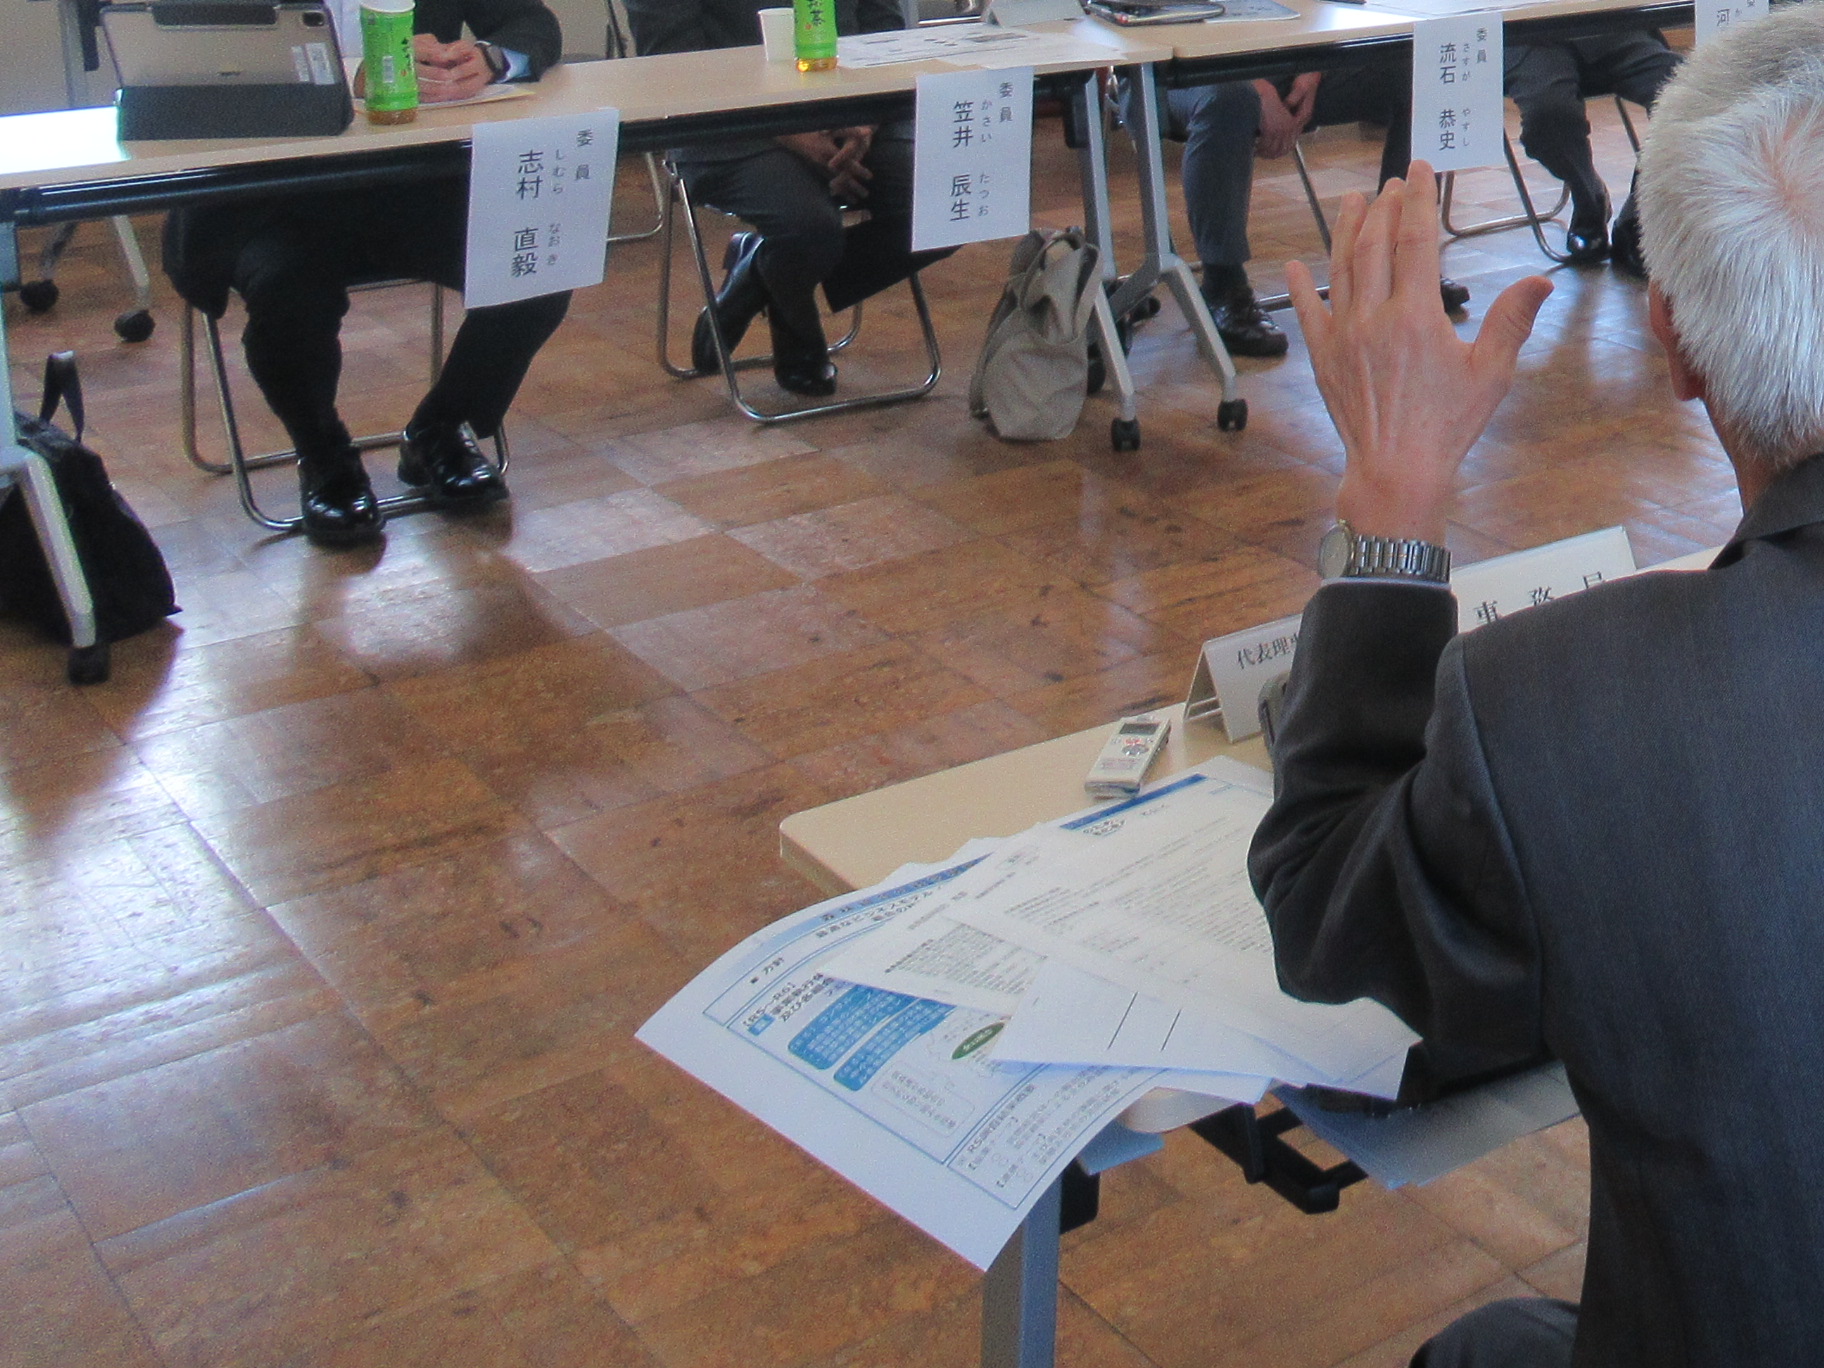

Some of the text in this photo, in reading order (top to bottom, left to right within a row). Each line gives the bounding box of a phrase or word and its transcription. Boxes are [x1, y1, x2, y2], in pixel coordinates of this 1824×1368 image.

[1439, 43, 1456, 151] 流石 恭史
[1462, 42, 1472, 83] さすが
[1476, 27, 1487, 63] 委員
[575, 128, 593, 181] 委員
[1000, 82, 1013, 122] 委員
[548, 149, 565, 265] しむら なおき
[950, 101, 974, 221] 笠井 辰生
[978, 99, 992, 217] かさい たつお
[511, 149, 544, 278] 志村 直毅
